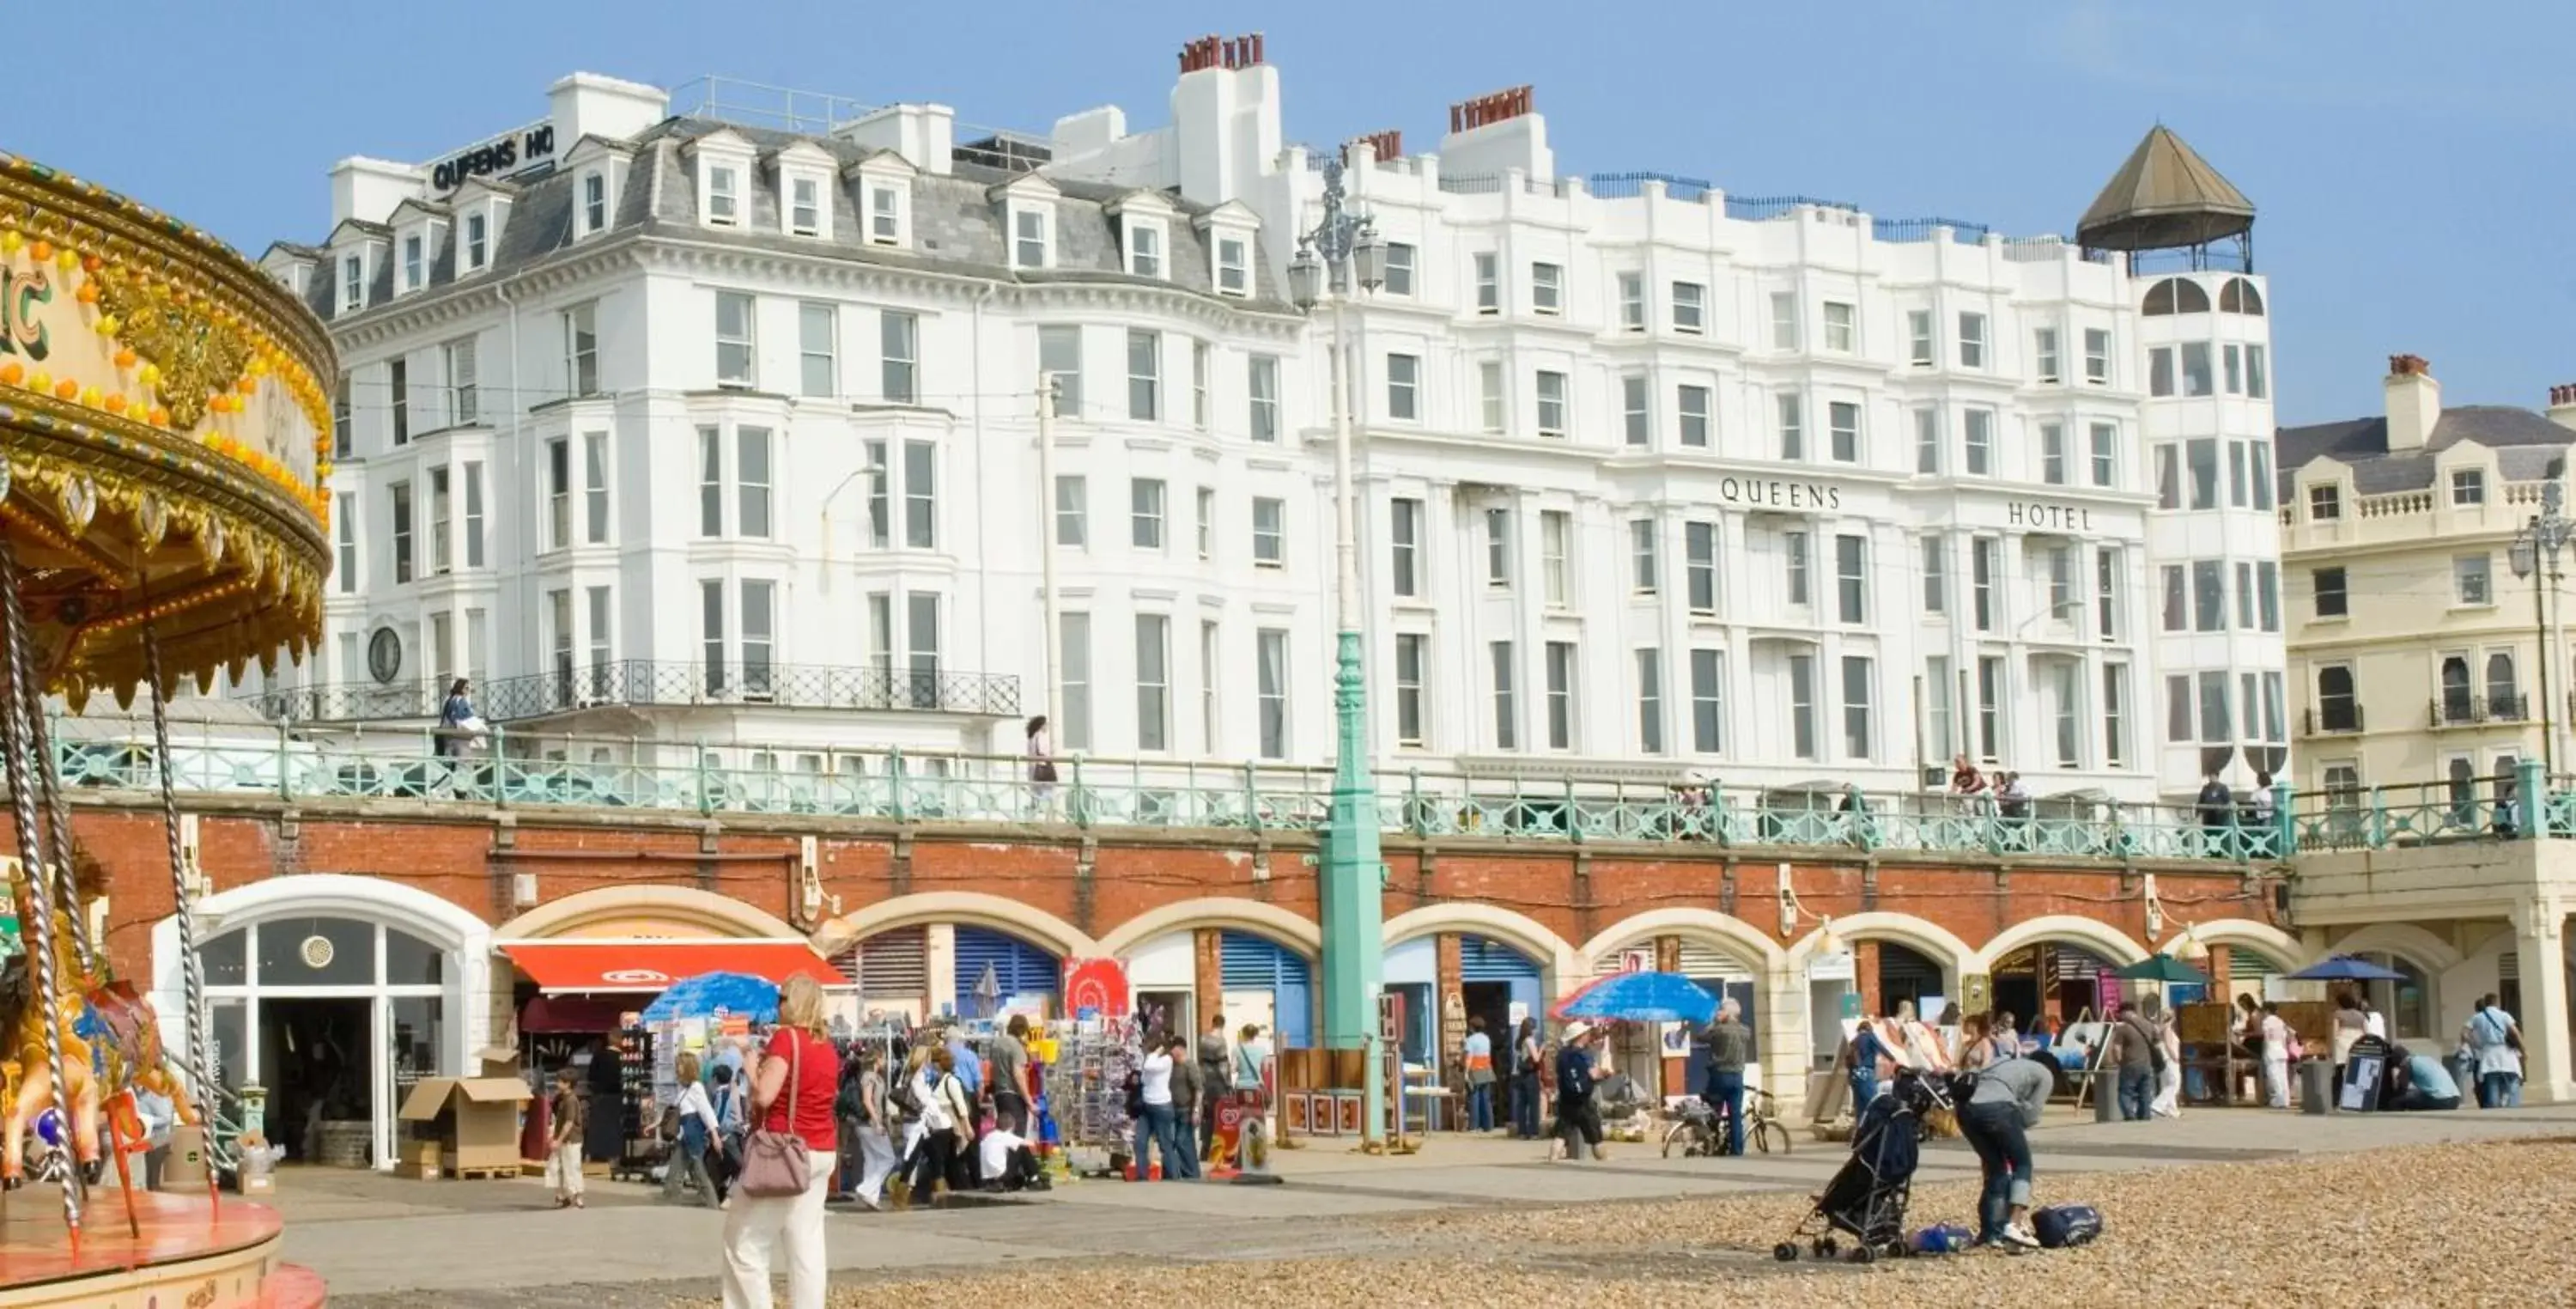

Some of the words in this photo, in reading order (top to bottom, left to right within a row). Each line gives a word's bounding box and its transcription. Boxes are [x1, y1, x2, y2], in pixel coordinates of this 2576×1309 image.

[434, 137, 517, 190] QUEENS
[1722, 477, 1839, 509] QUEENS
[2008, 502, 2093, 531] HOTEL
